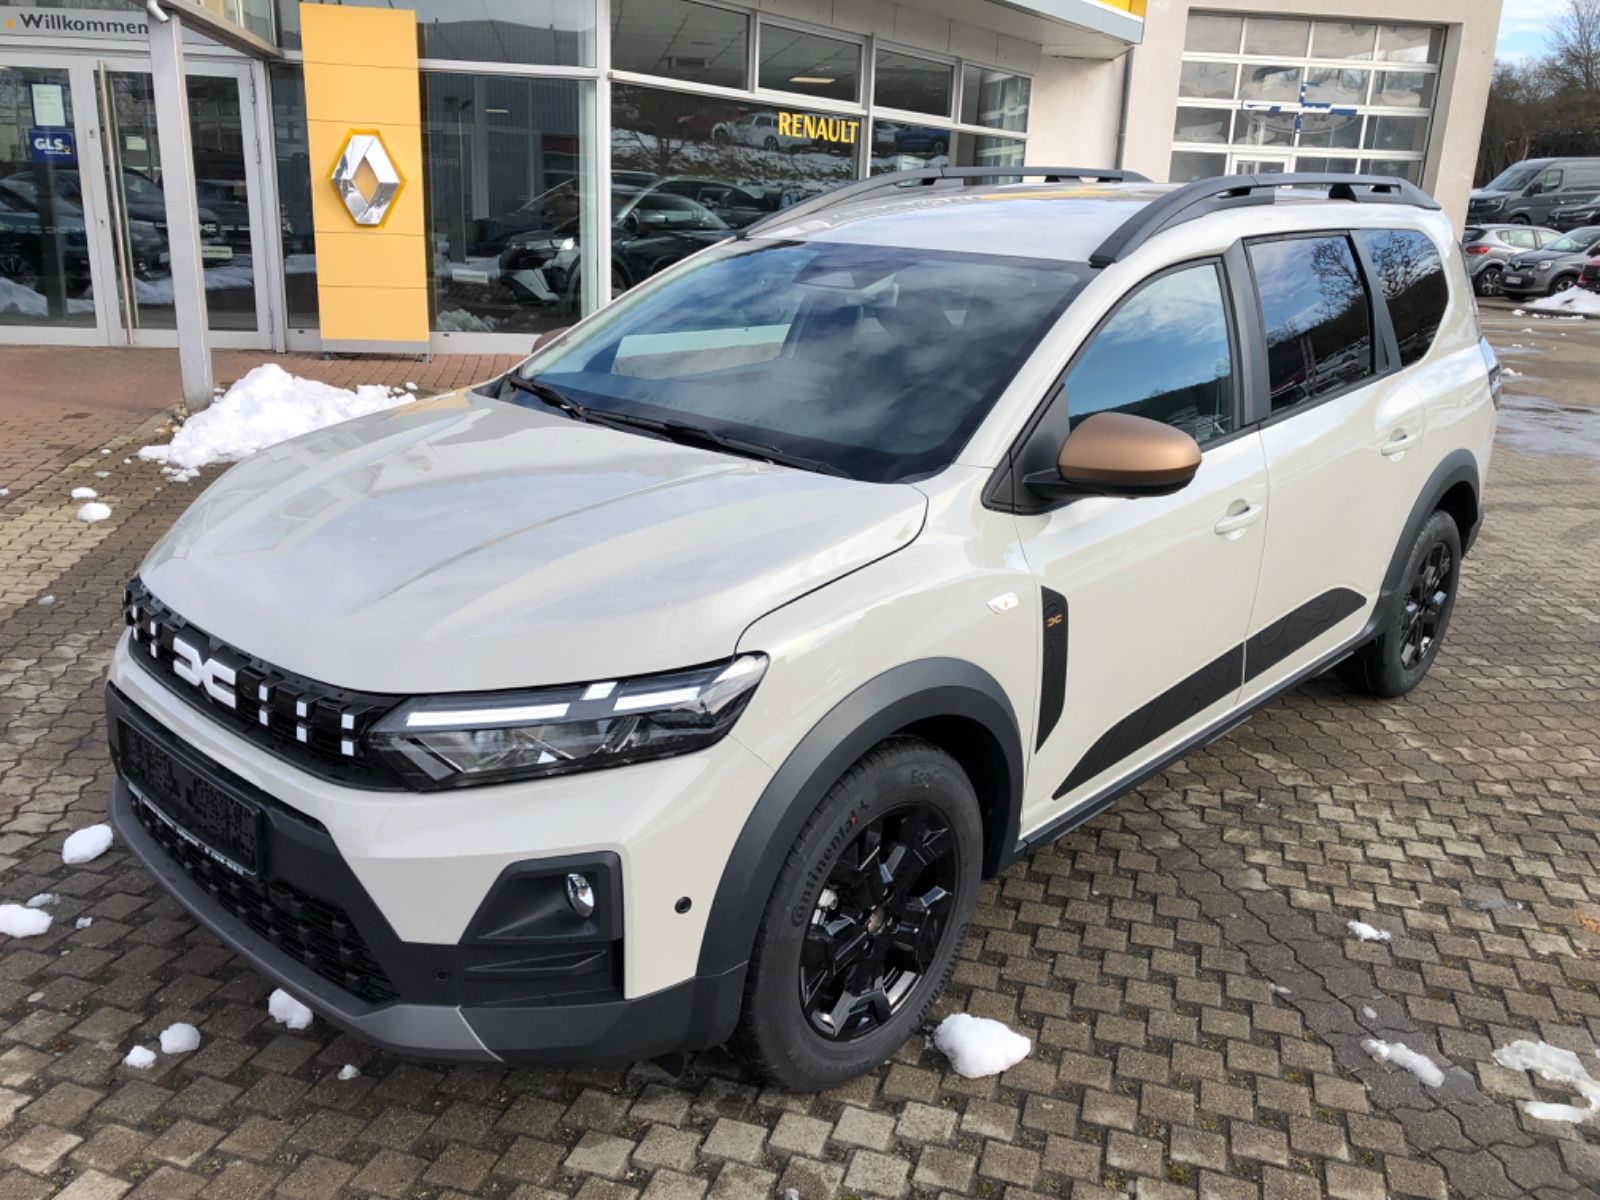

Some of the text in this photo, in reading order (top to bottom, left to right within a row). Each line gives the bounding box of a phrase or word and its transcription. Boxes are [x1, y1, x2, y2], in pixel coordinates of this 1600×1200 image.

[20, 12, 150, 35] Willkommen
[778, 111, 860, 144] RENAULT
[33, 137, 65, 150] GLS
